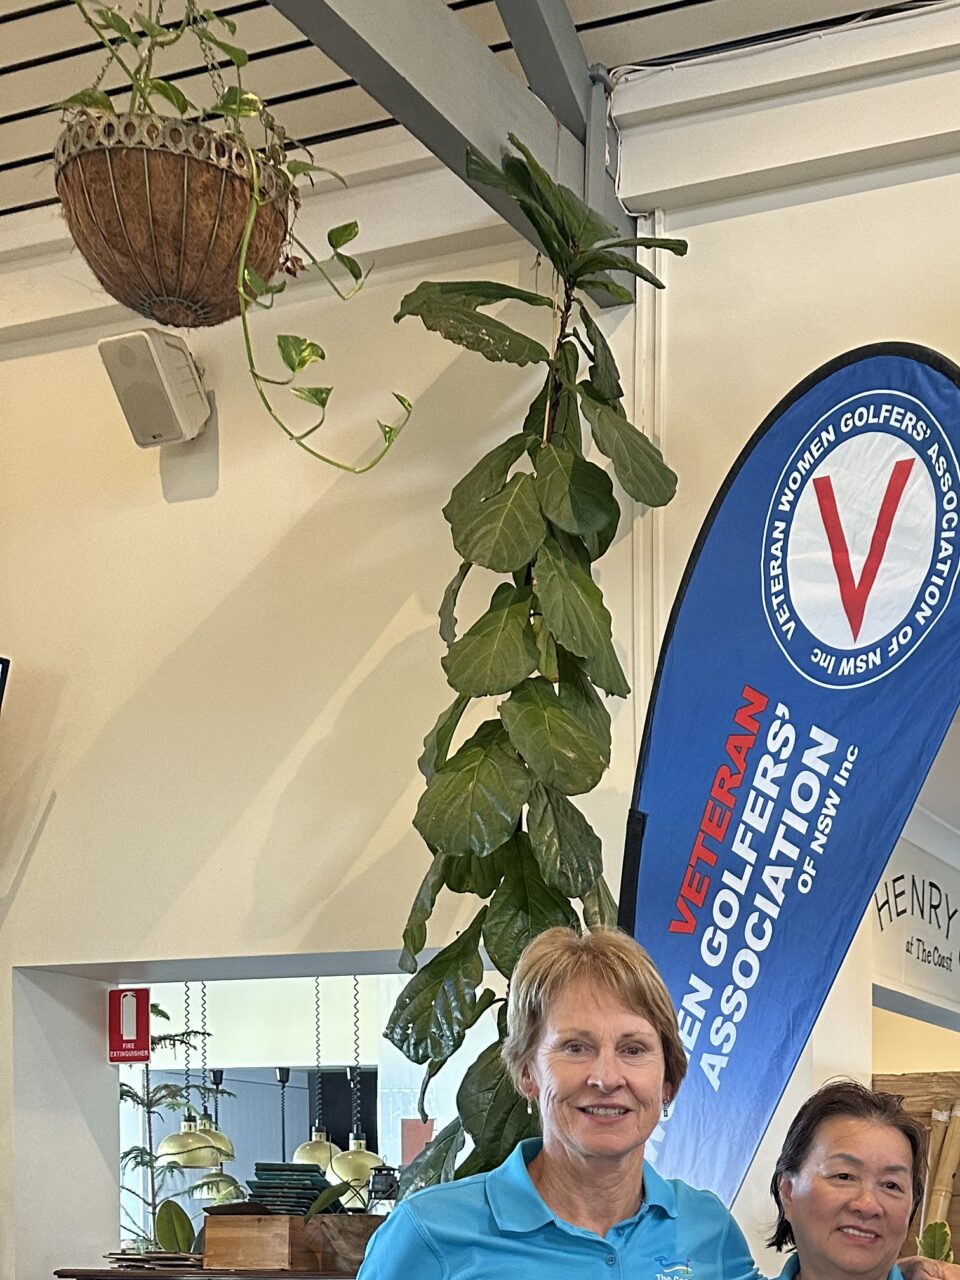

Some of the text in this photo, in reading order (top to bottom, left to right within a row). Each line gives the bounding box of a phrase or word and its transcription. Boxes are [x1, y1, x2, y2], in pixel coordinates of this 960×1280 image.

[778, 424, 837, 513] WOMEN
[915, 442, 959, 626] ASSOCIATION
[770, 521, 796, 641] VETERAN
[812, 457, 916, 644] V
[810, 647, 836, 675] Inc
[838, 647, 883, 676] NSW
[888, 624, 914, 658] OF
[668, 684, 769, 935] VETERAN
[700, 702, 796, 968] GOLFERS'
[797, 744, 859, 895] OF NSW Inc
[700, 725, 839, 1092] ASSOCIATION
[905, 936, 953, 972] at The Coast
